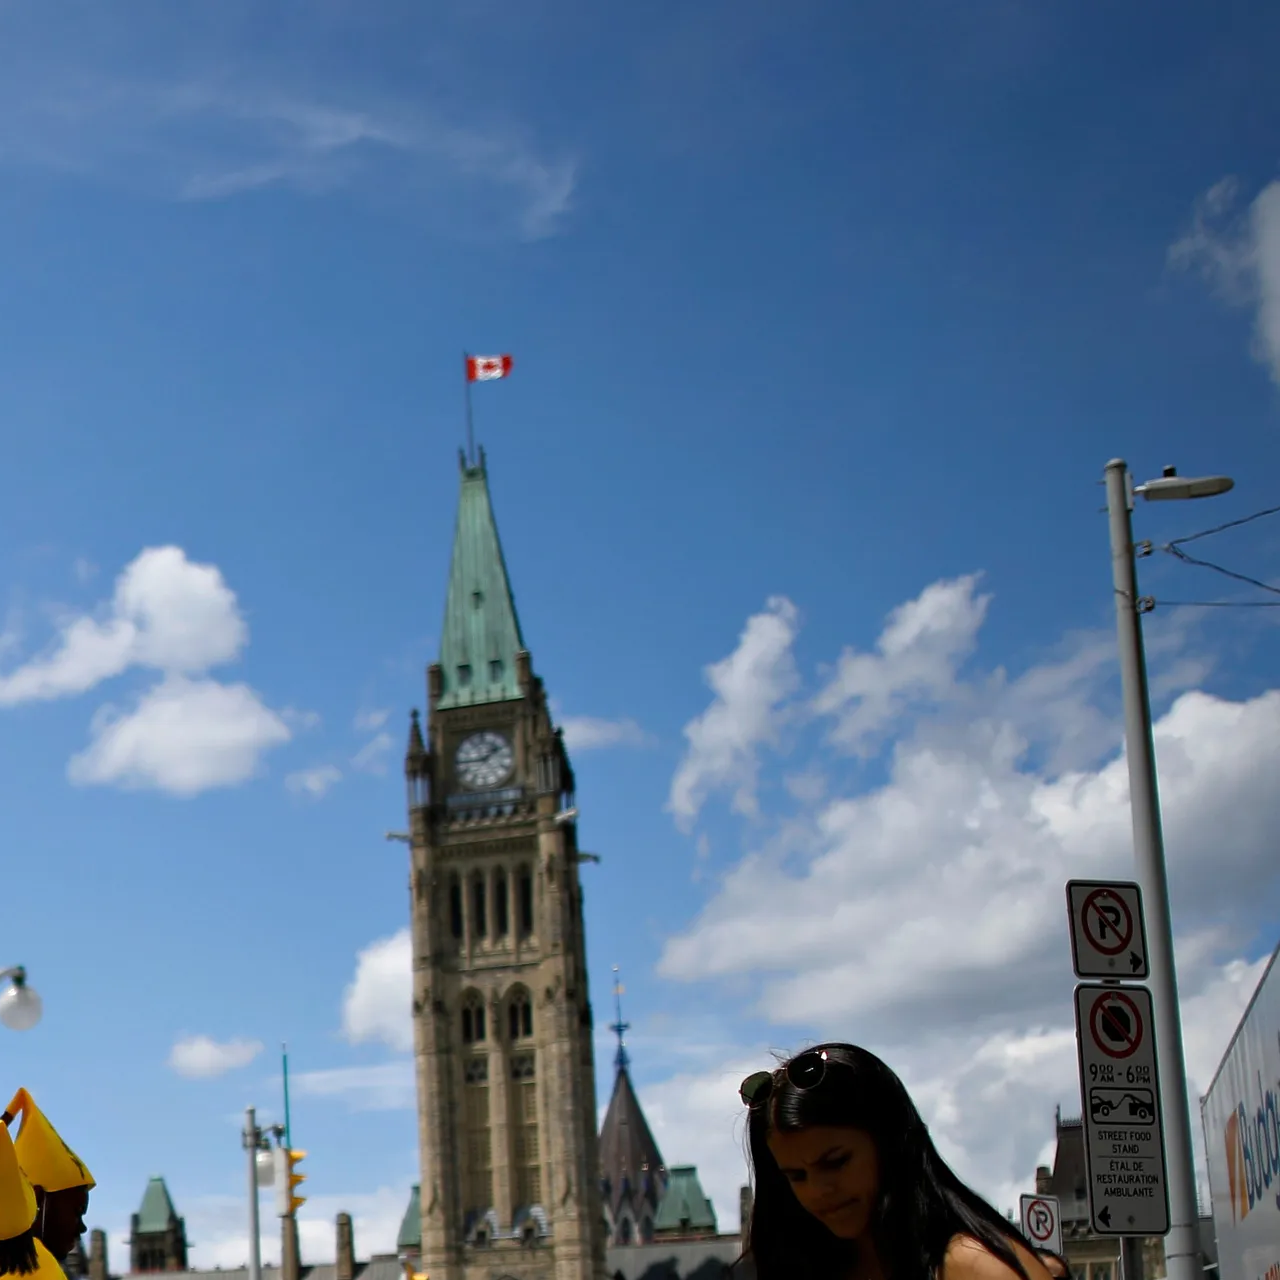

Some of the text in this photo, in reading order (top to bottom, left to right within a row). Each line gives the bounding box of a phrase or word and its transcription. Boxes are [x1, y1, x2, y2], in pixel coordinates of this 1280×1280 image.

[1098, 1130, 1152, 1142] STREET FOOD
[1112, 1144, 1140, 1154] STAND
[1109, 1160, 1144, 1172] ÉTAL DE
[1096, 1174, 1159, 1185] RESTAURATION
[1103, 1187, 1155, 1198] AMBULANTE
